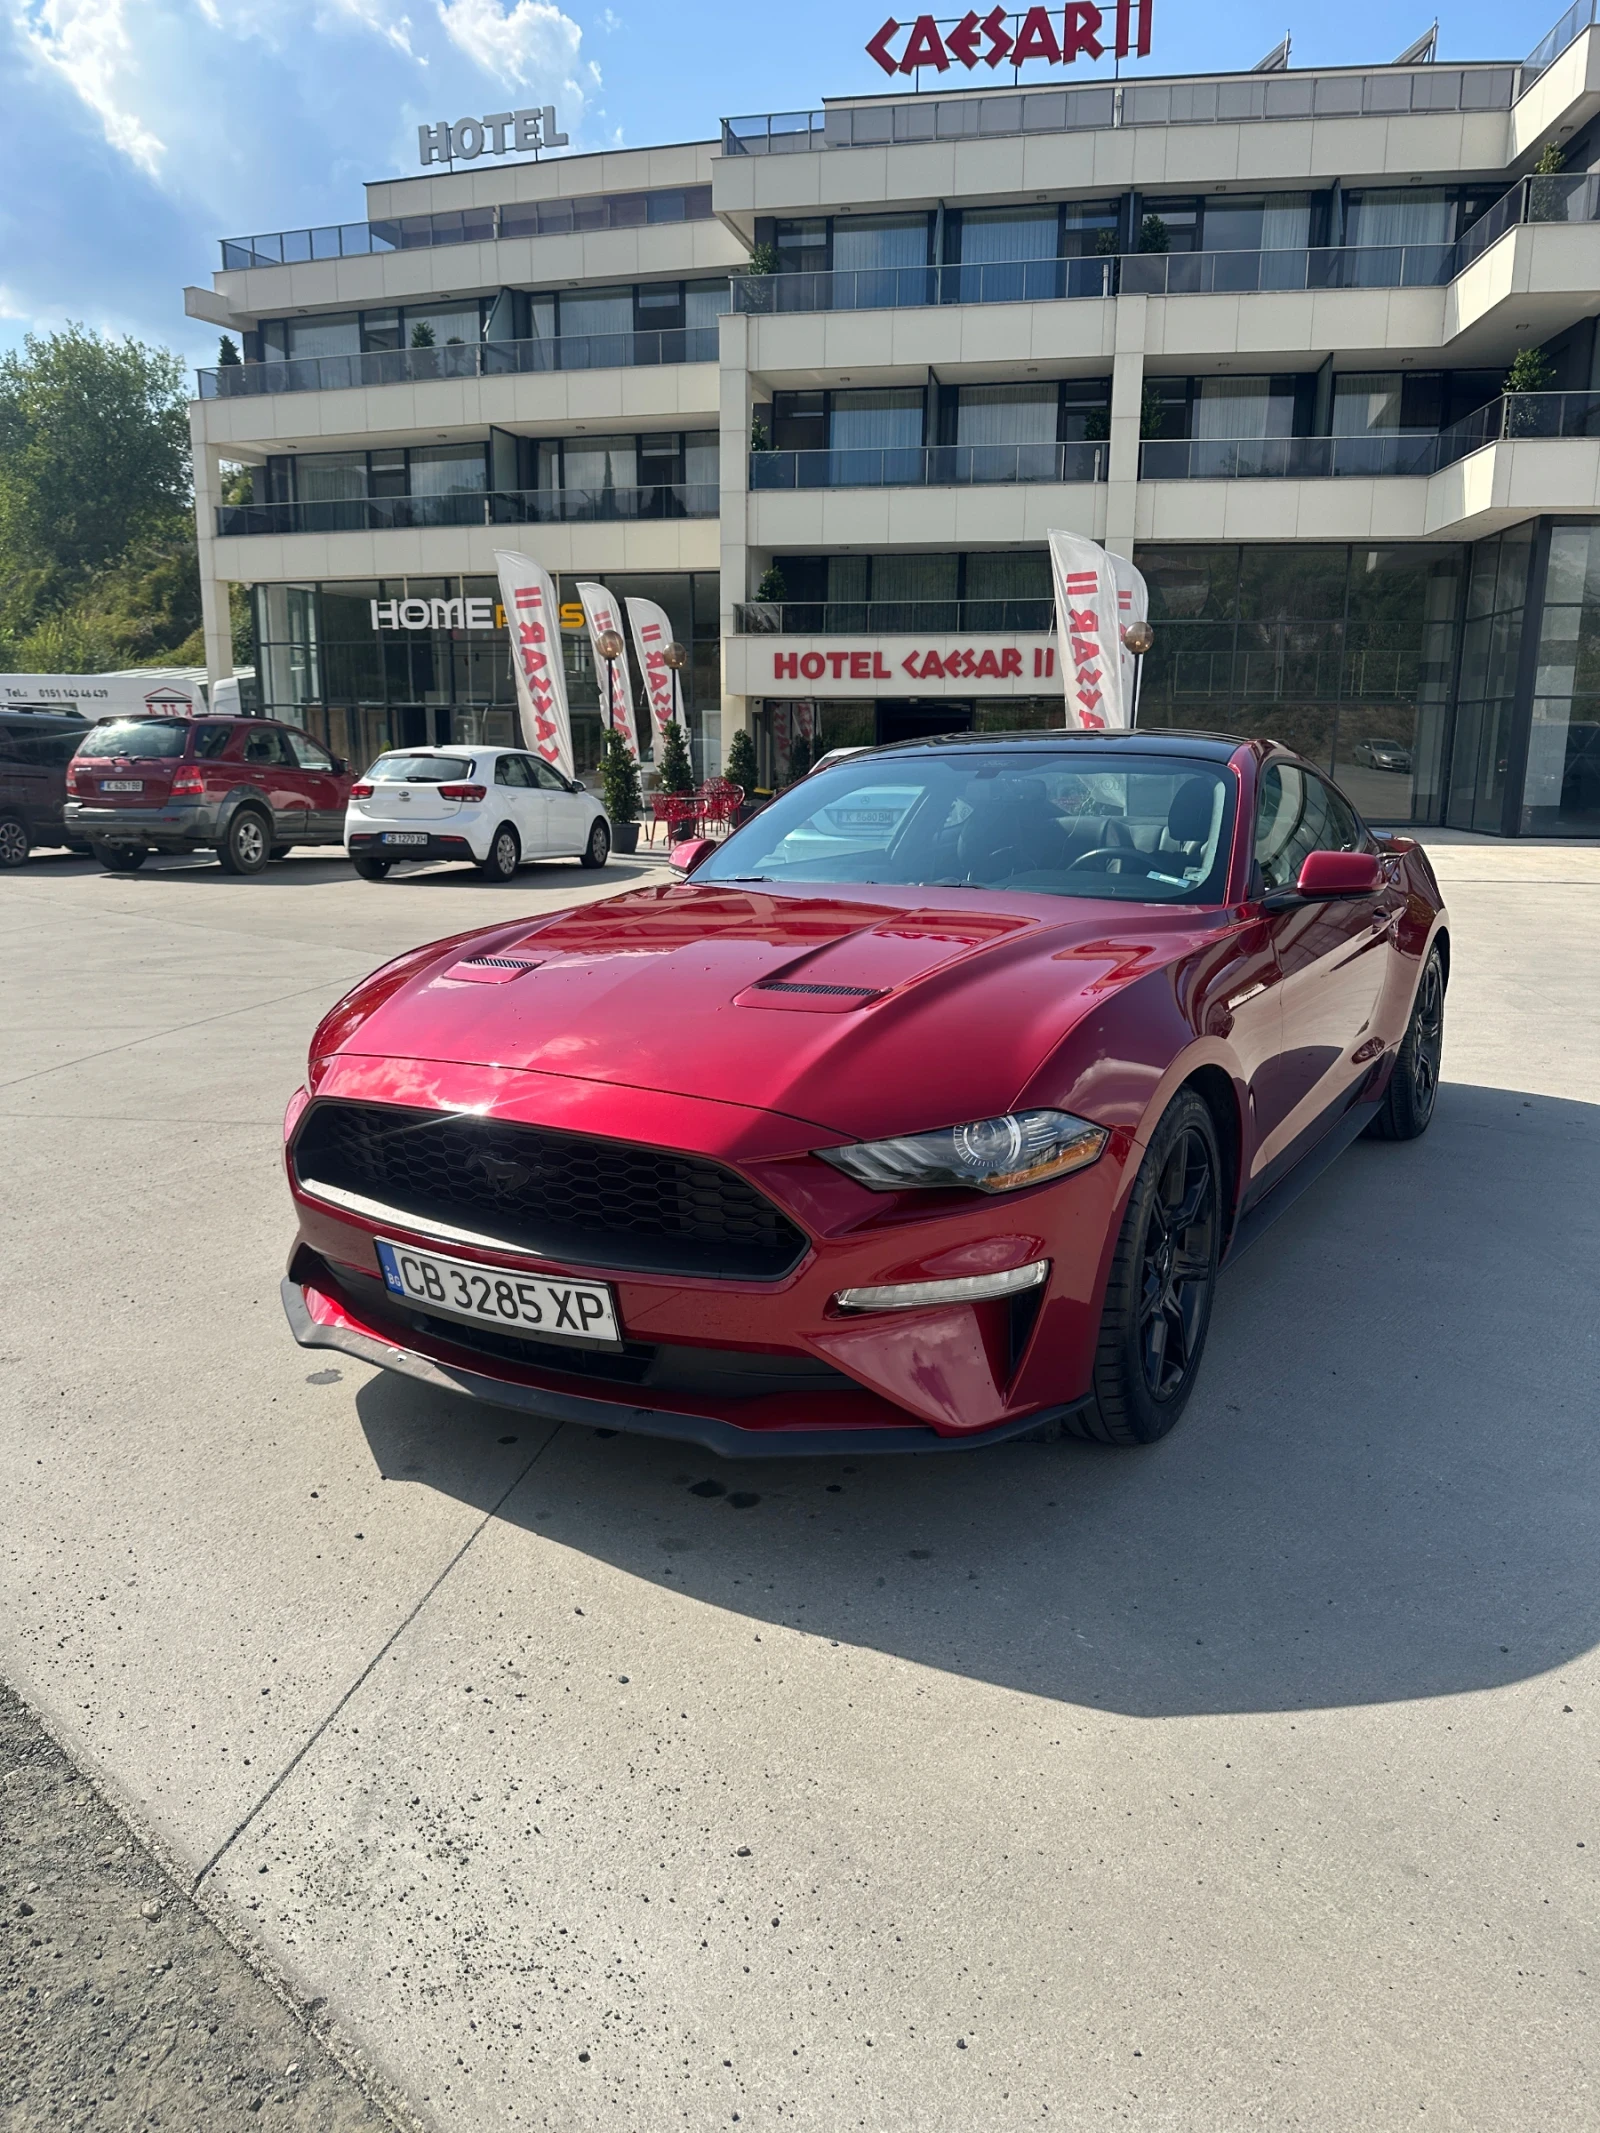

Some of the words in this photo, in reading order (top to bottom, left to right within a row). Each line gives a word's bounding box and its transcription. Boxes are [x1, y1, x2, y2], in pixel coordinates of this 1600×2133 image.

[865, 0, 1105, 77] CAESAR
[418, 105, 569, 166] HOTEL
[774, 652, 892, 680] HOTEL
[901, 648, 1023, 680] CAESAR
[387, 1272, 402, 1287] BG
[400, 1256, 446, 1302] CB
[450, 1270, 543, 1324] 3285
[547, 1287, 604, 1331] XP
